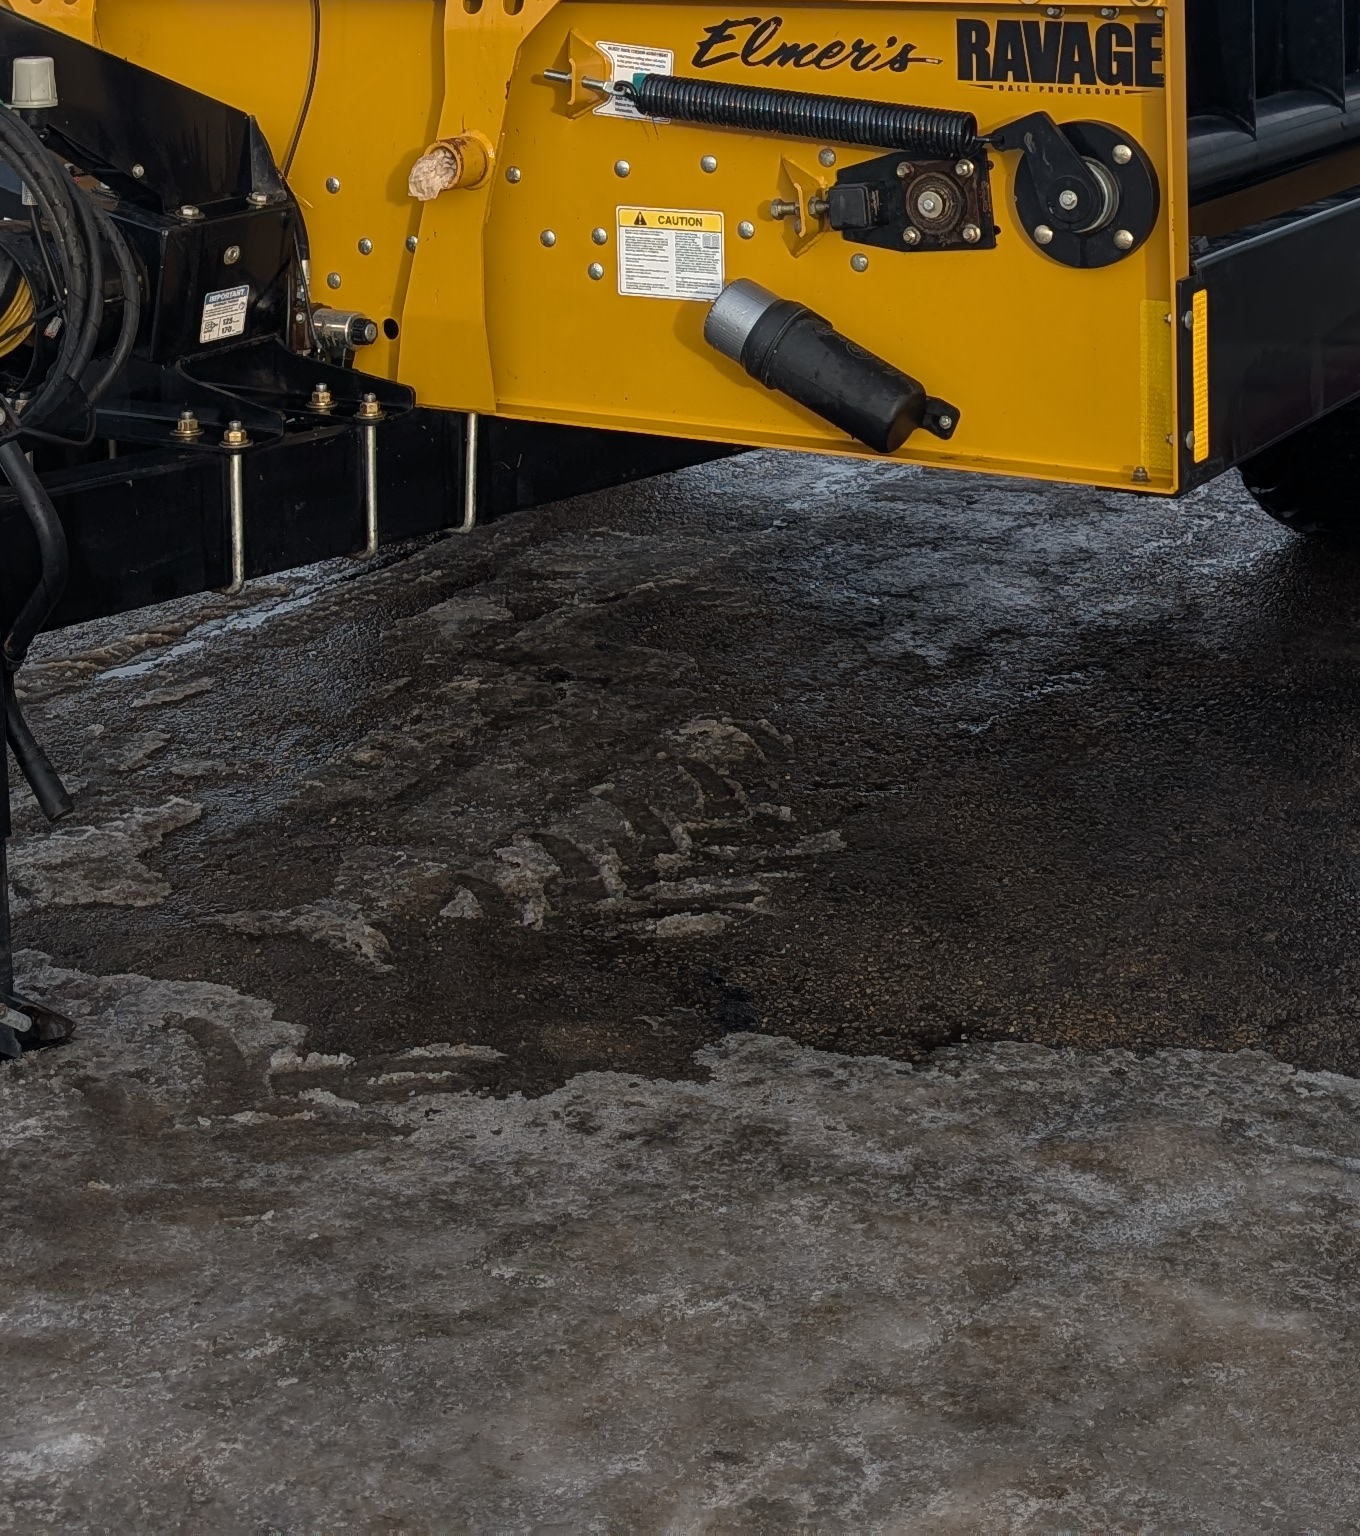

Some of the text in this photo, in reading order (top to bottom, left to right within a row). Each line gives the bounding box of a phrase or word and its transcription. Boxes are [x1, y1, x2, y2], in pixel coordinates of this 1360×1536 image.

[691, 16, 943, 73] Elmer's
[956, 18, 1165, 88] RAVAGE
[998, 84, 1120, 96] BALE PROCESSOR
[657, 215, 704, 228] CAUTION
